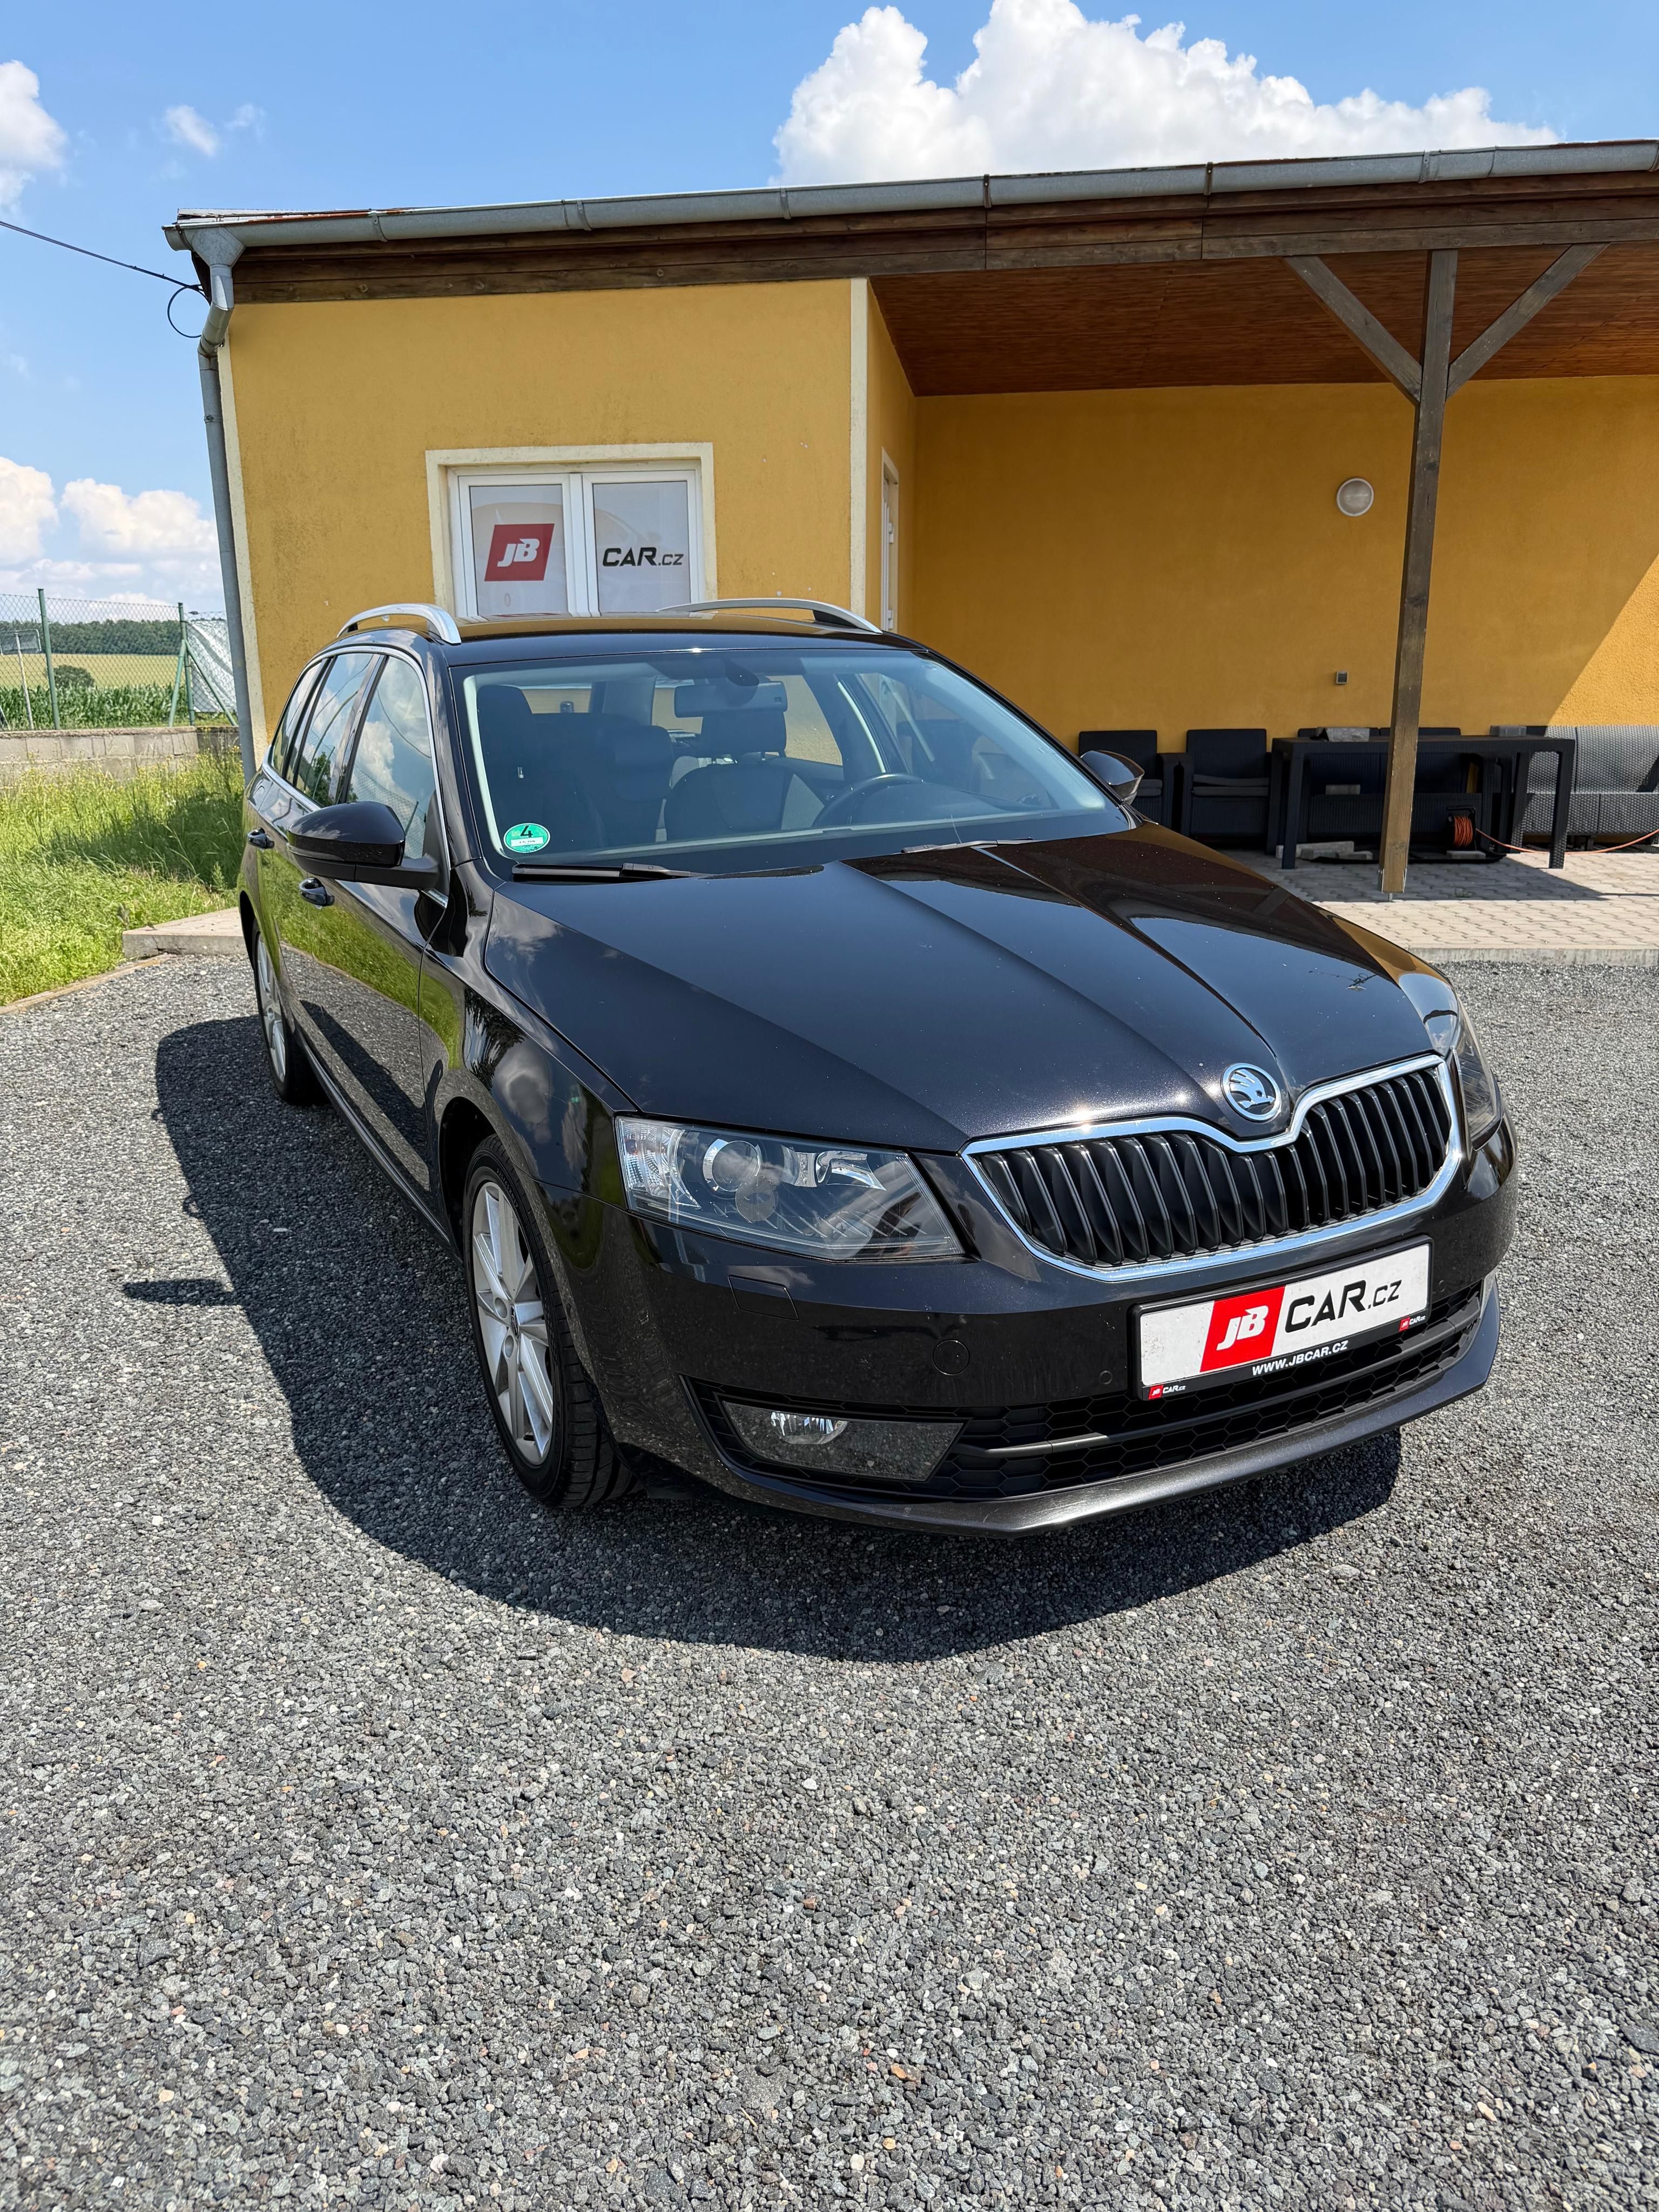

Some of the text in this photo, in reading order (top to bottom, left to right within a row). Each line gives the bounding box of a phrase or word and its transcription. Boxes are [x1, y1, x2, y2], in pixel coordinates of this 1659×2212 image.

[497, 538, 540, 567] JB
[520, 825, 533, 838] 4
[1216, 1305, 1269, 1351] JB
[1252, 1340, 1348, 1376] WWW.JBCAR.CZ
